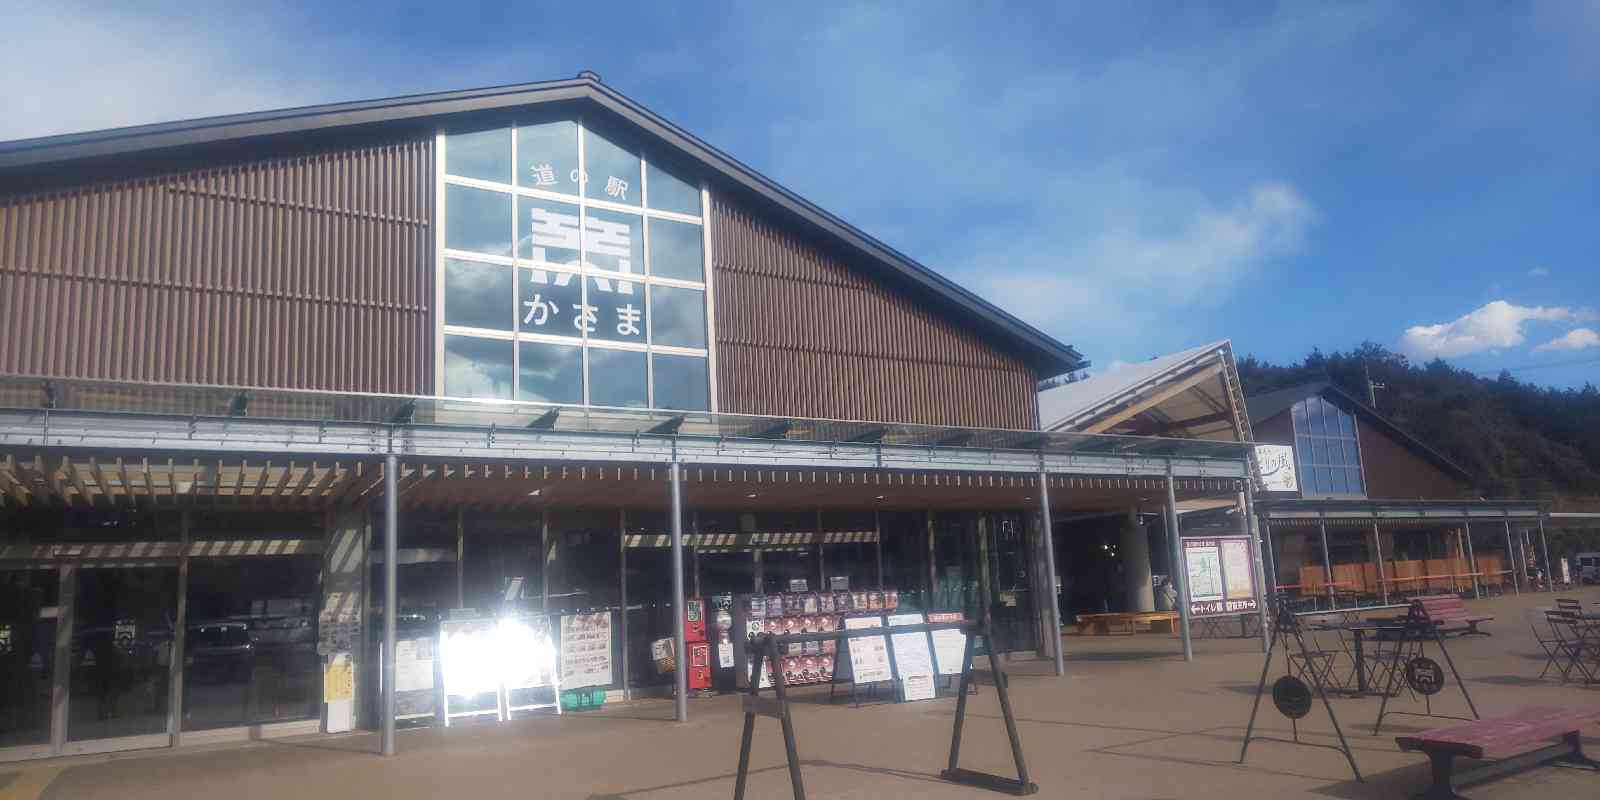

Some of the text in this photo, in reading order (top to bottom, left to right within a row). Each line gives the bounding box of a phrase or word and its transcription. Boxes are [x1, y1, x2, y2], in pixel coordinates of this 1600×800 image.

[530, 164, 629, 200] 道の駅
[523, 294, 641, 336] かさま
[1201, 602, 1217, 613] トイレ
